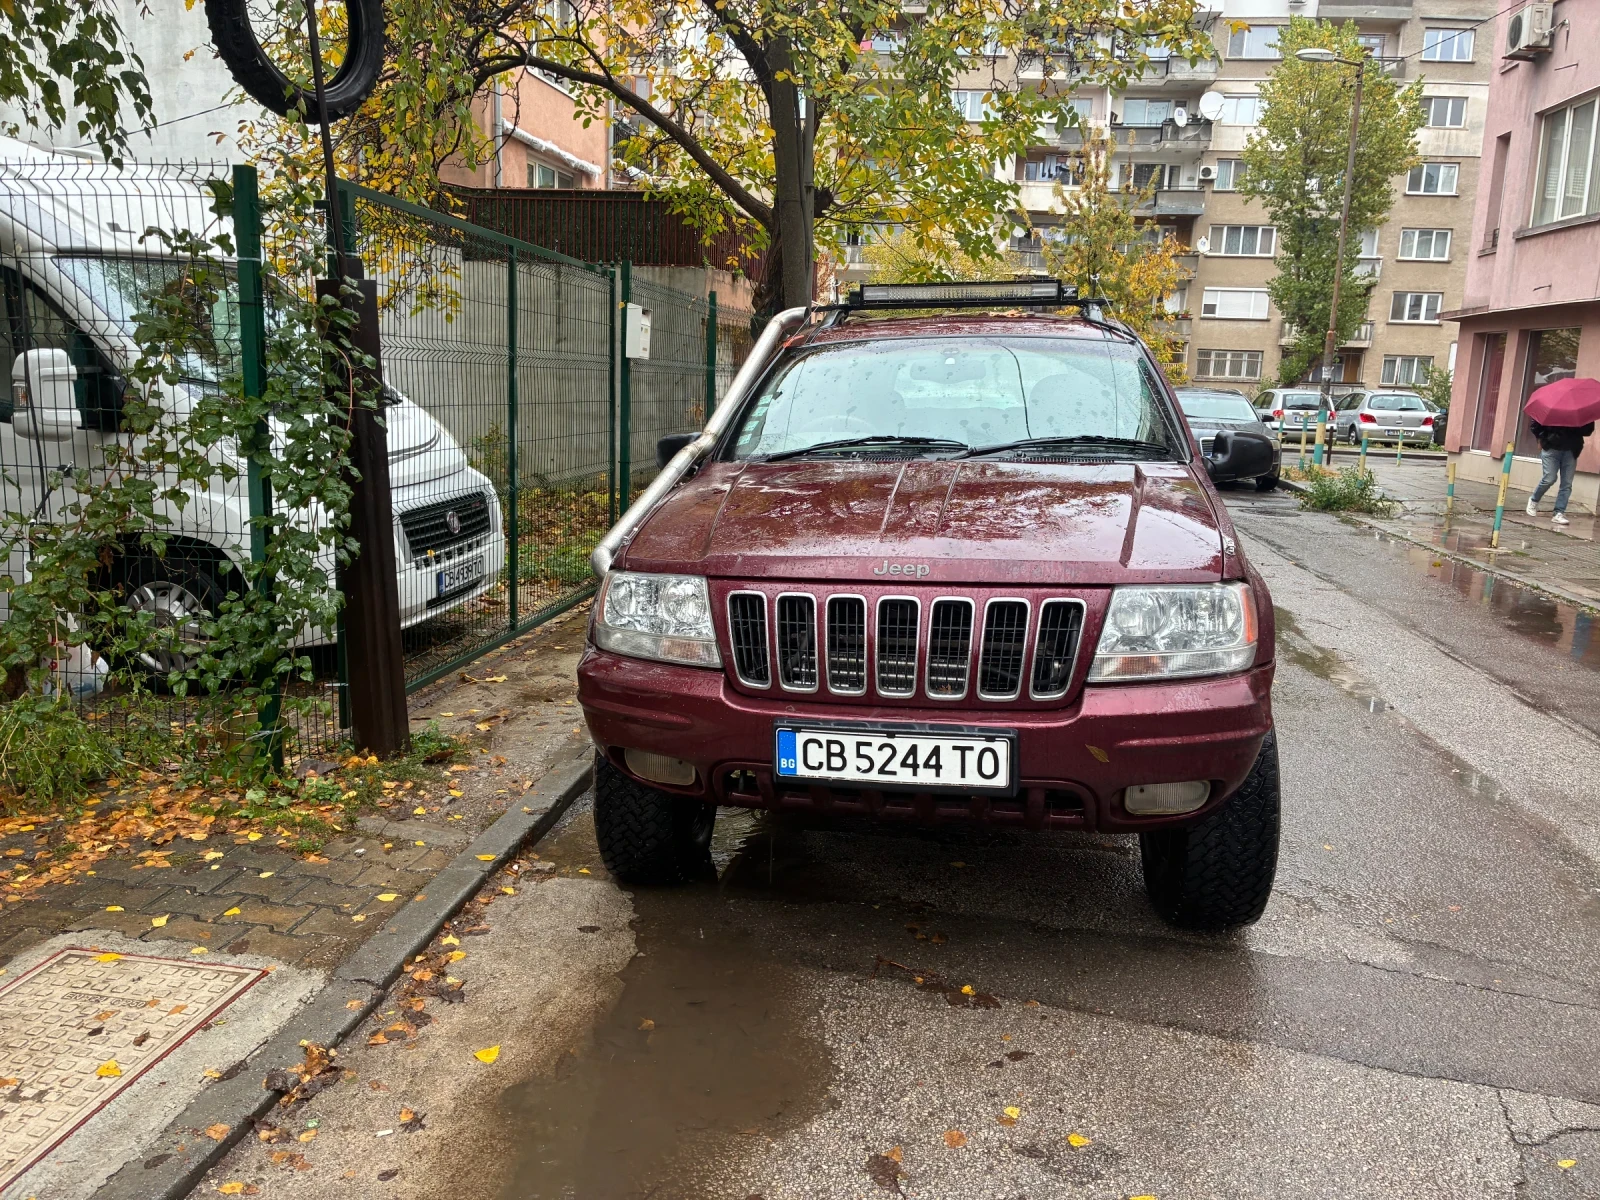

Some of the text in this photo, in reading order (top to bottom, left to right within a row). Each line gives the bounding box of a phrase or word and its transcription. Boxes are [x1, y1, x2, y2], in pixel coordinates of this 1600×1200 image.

[873, 560, 930, 579] Jeep
[780, 758, 796, 769] BG
[802, 738, 1000, 780] CB 5244 TO
